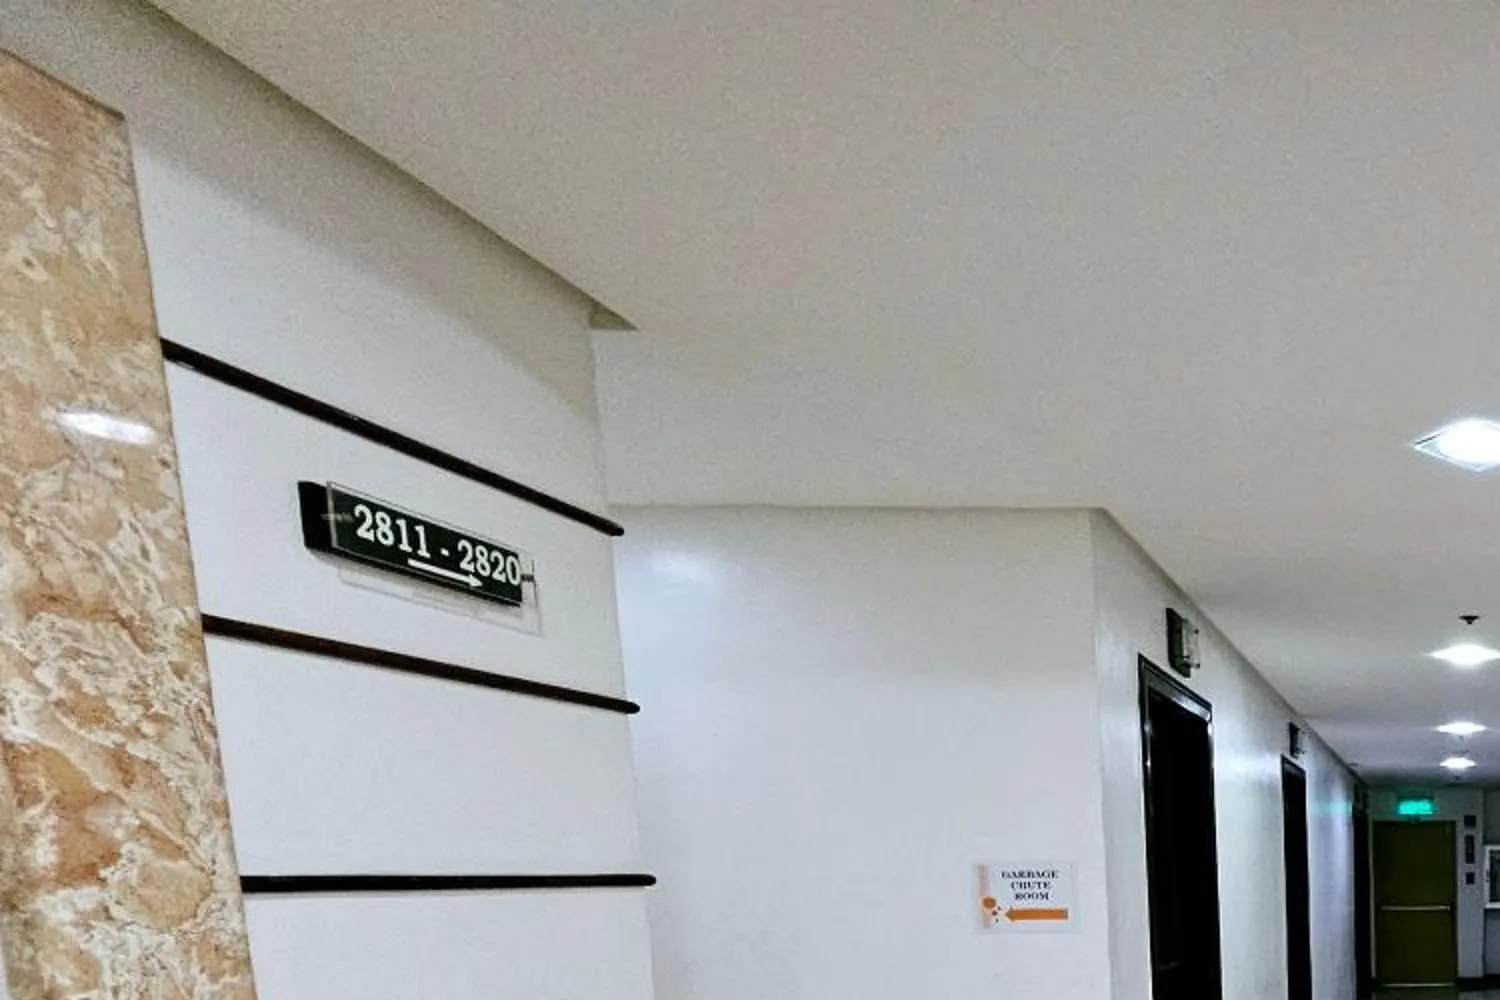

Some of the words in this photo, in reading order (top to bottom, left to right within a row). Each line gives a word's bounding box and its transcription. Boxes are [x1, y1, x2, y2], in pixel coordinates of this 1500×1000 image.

[354, 504, 430, 558] 2811
[457, 539, 521, 586] 2820
[1001, 870, 1060, 879] GARBAGE
[1011, 881, 1051, 890] CHUTE
[1015, 892, 1050, 900] ROOM
